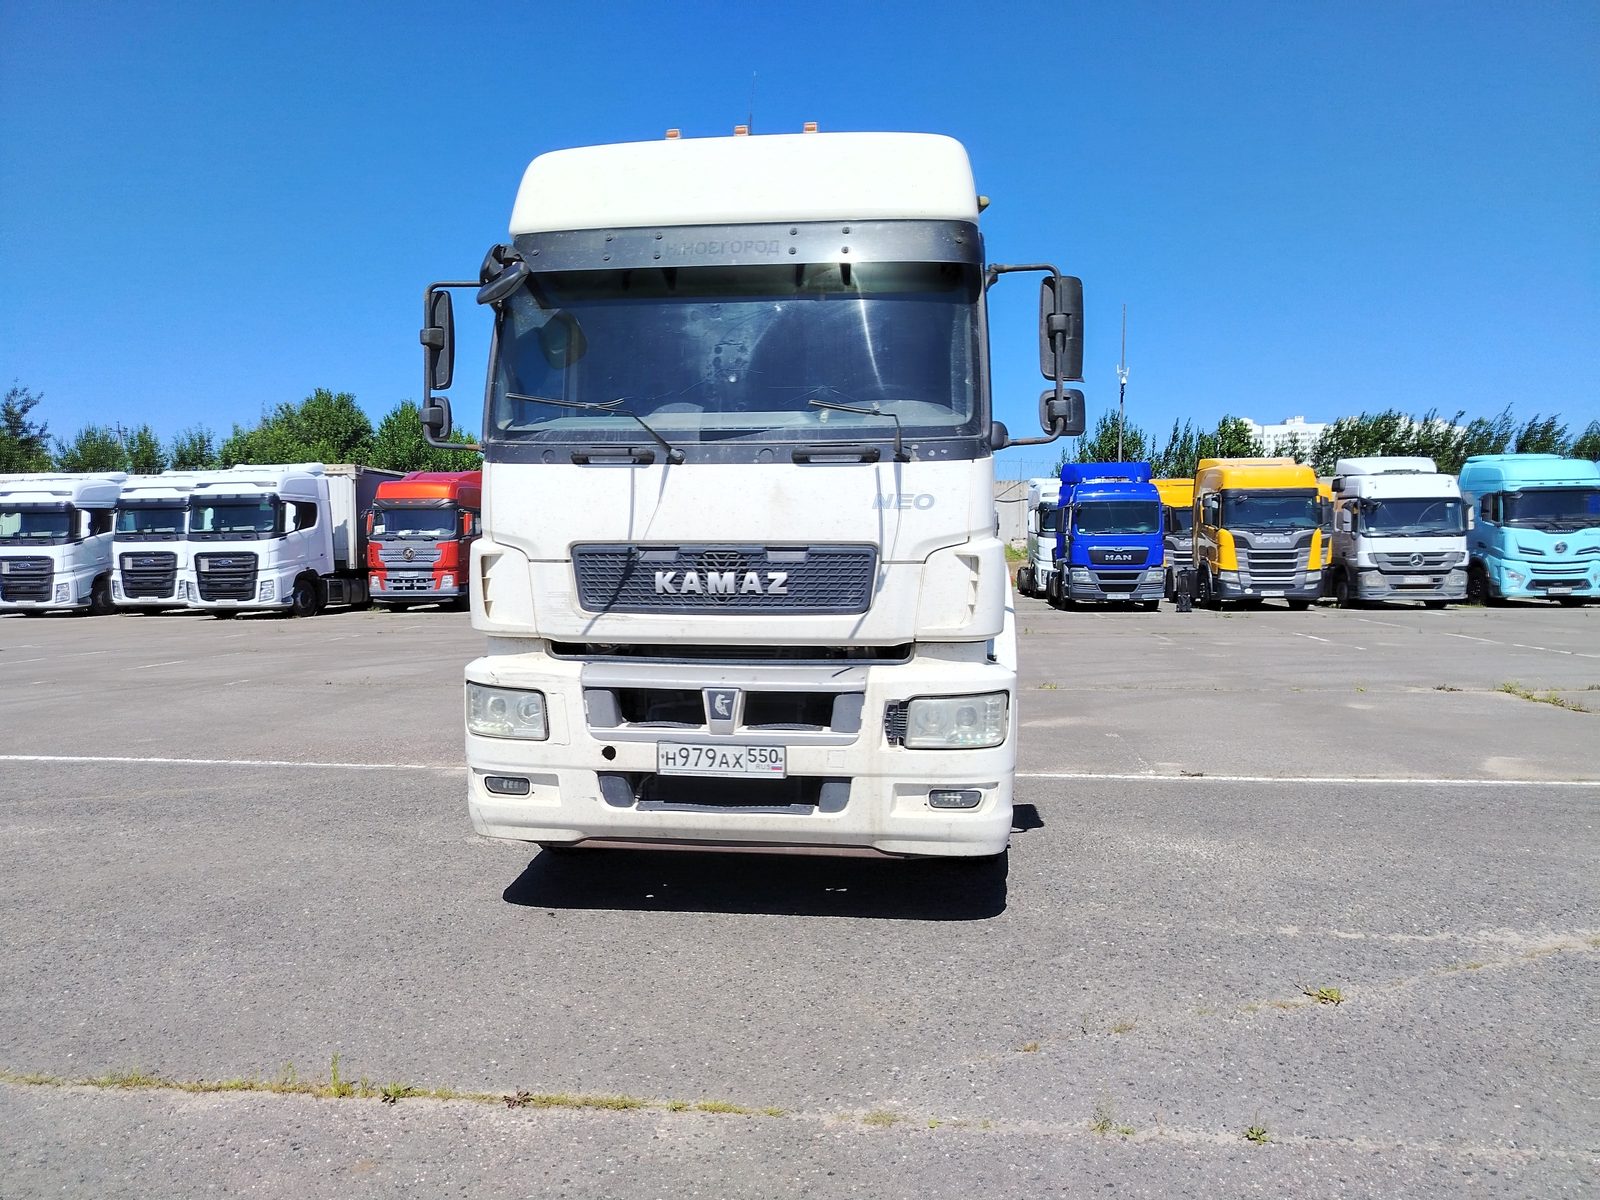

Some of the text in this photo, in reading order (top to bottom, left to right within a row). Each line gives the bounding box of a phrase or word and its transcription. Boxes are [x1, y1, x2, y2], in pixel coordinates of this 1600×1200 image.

[872, 493, 935, 510] NEO
[1255, 536, 1291, 544] SCANIA
[655, 571, 788, 594] KAMAZ
[747, 748, 779, 764] 550
